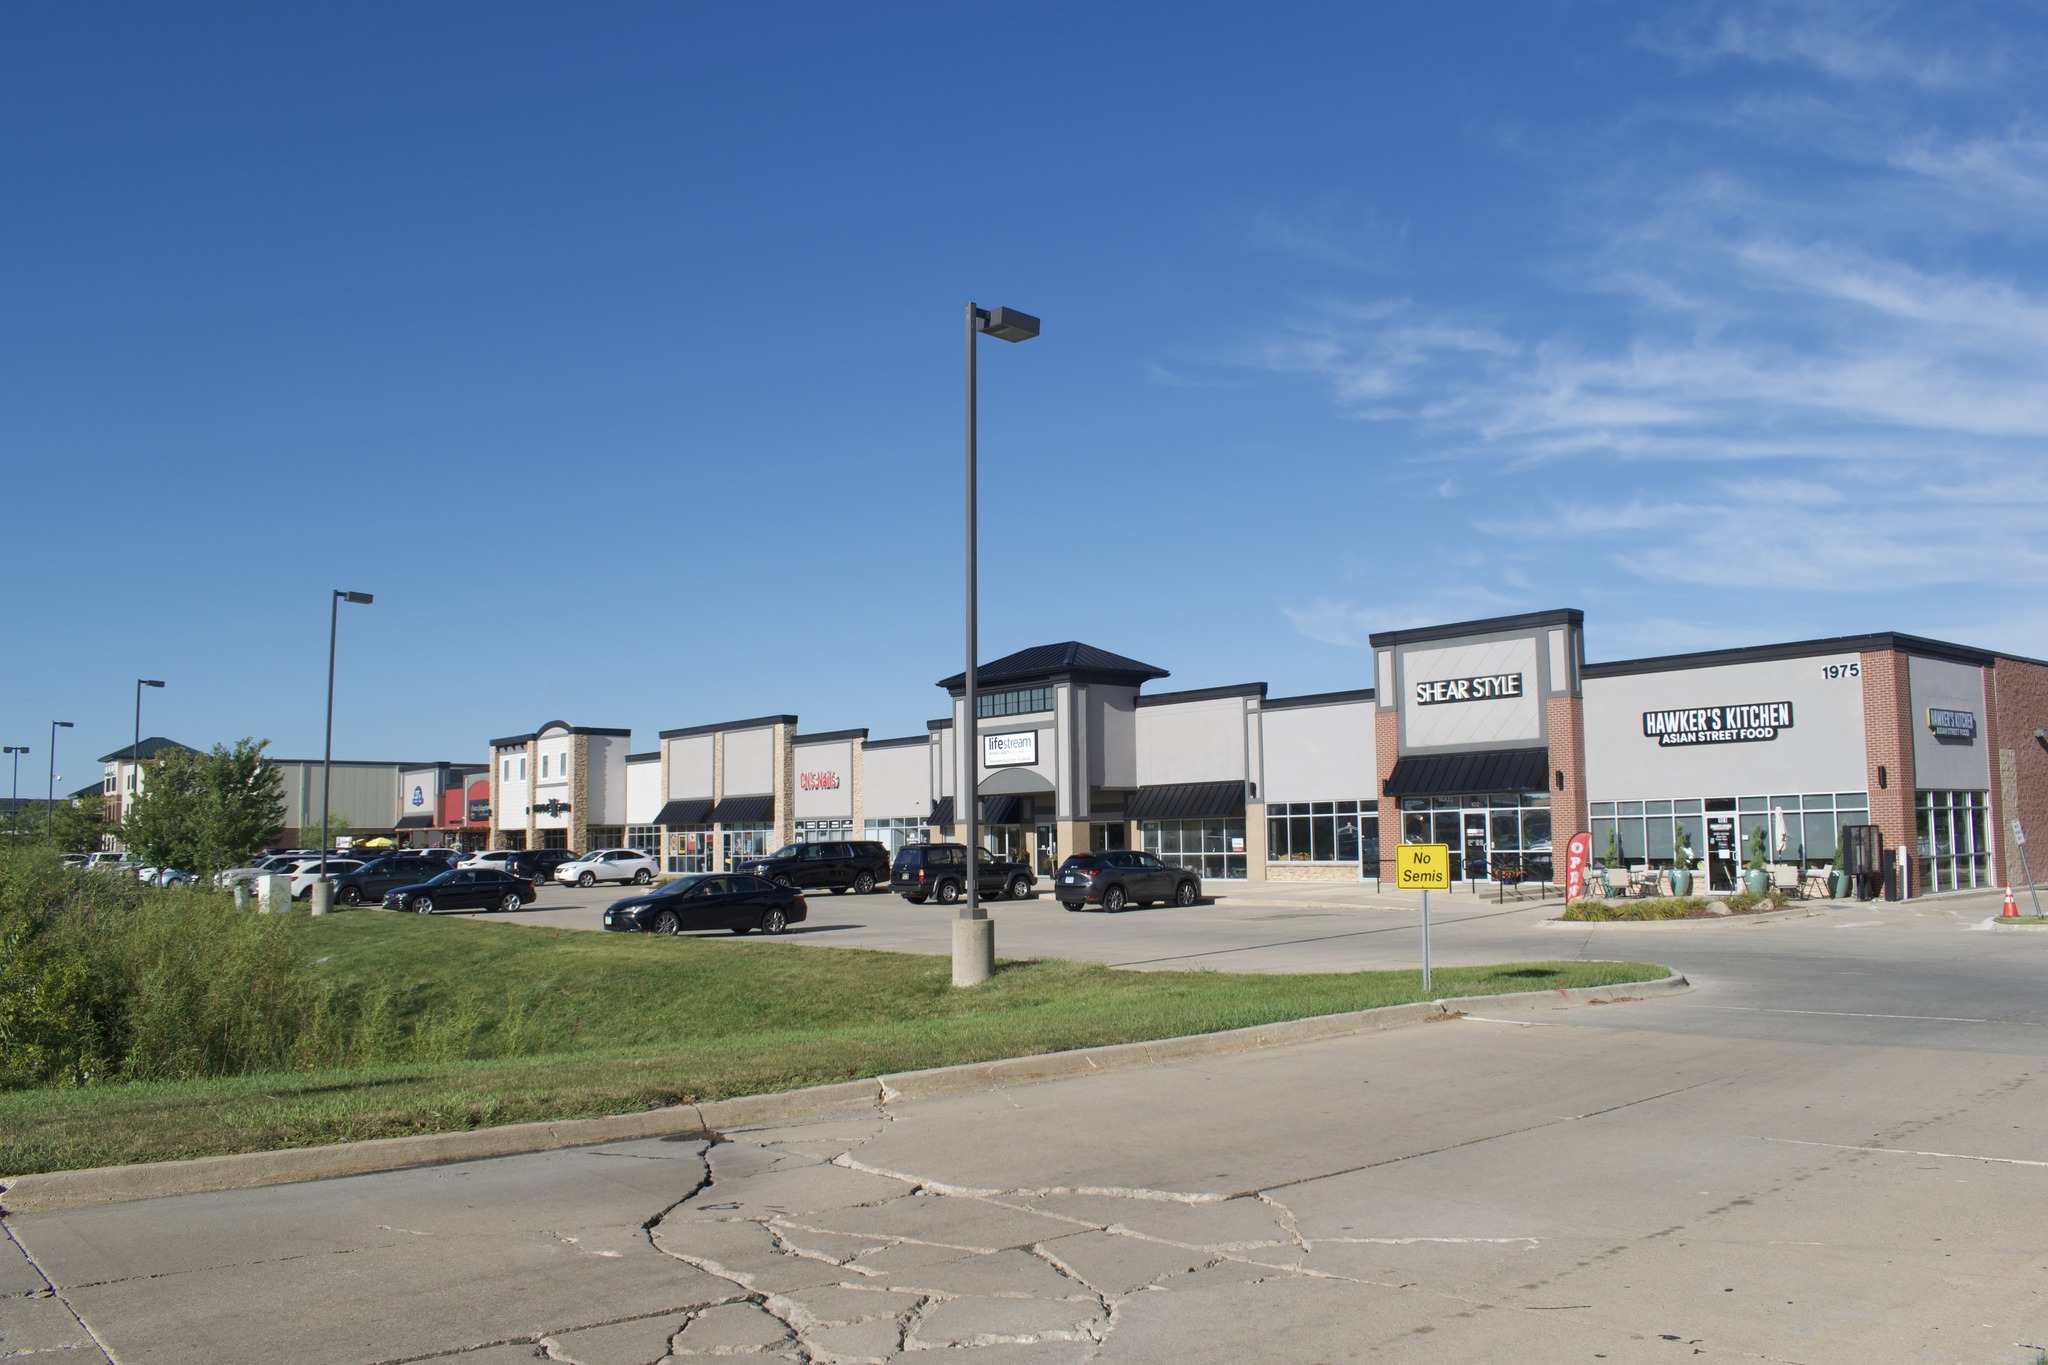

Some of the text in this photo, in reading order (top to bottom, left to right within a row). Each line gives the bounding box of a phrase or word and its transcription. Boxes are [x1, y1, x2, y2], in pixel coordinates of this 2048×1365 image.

[1822, 663, 1859, 679] 1975
[1416, 675, 1520, 702] SHEAR STYLE
[1646, 703, 1790, 734] HAWKER'S KITCHEN
[1662, 728, 1774, 744] ASIAN STREET FOOD
[800, 770, 836, 789] CN's Nails
[1413, 852, 1431, 864] No
[1403, 869, 1443, 882] Semis
[1567, 841, 1584, 899] OPEN
